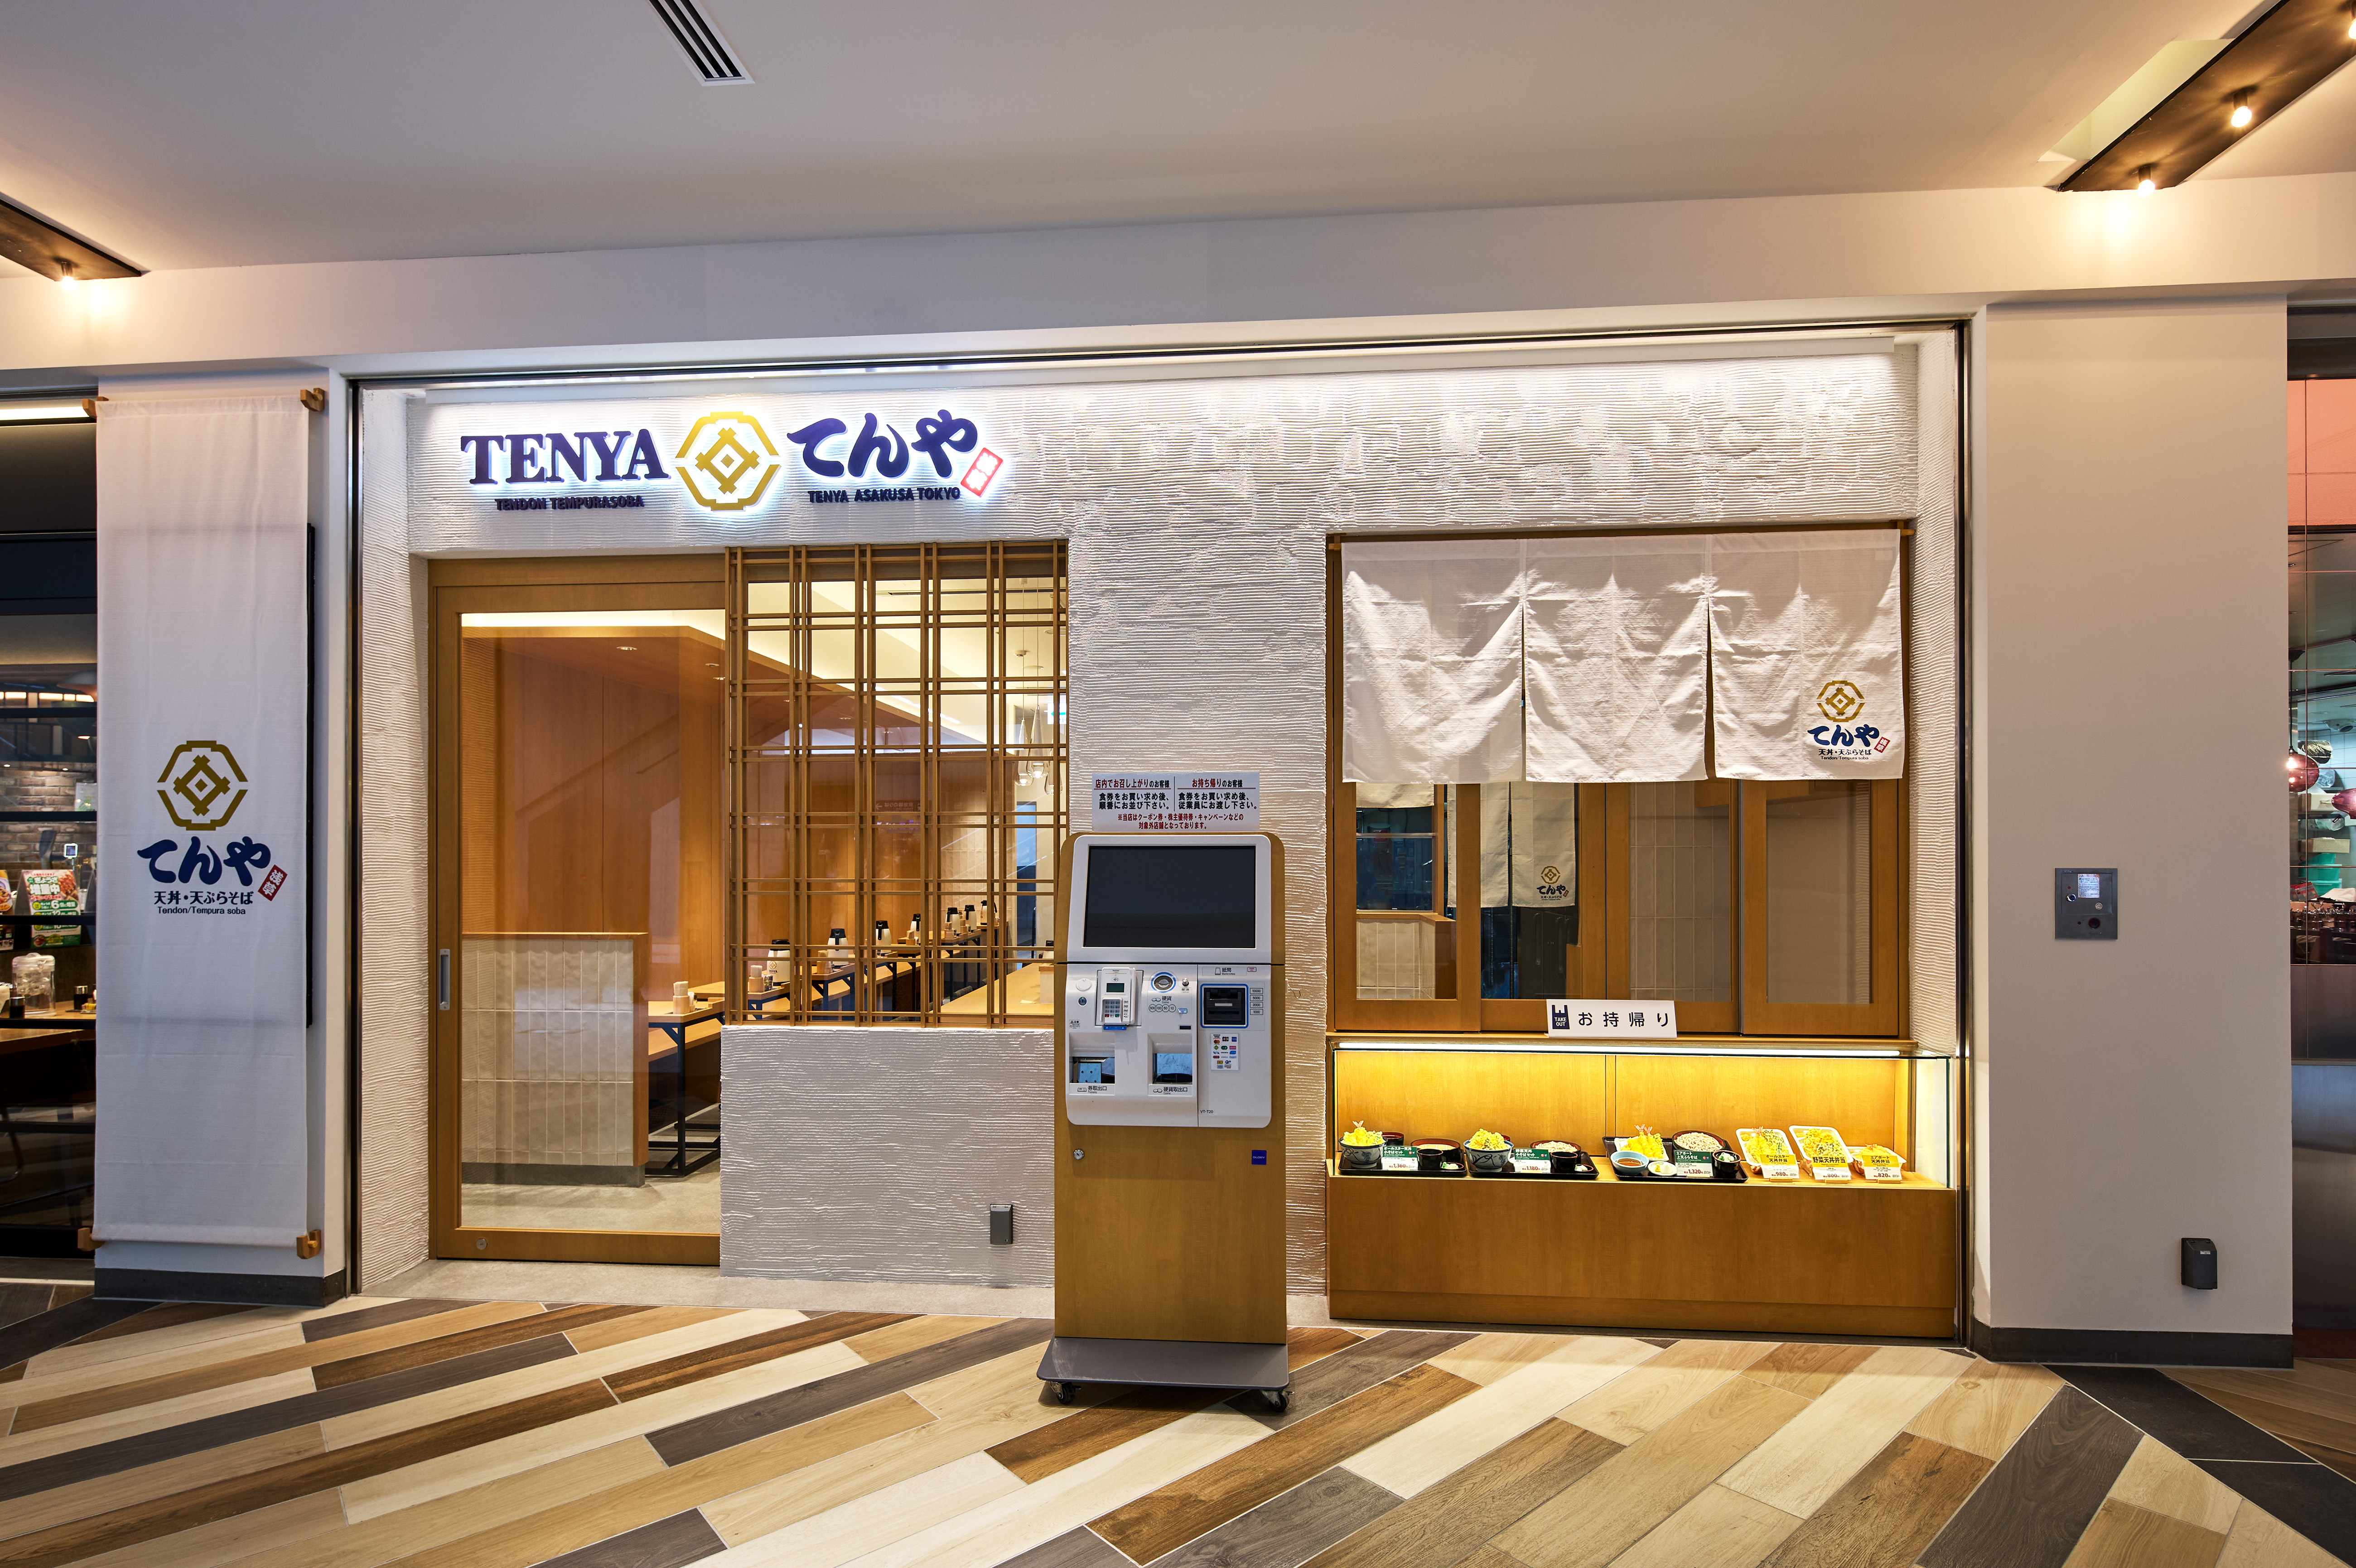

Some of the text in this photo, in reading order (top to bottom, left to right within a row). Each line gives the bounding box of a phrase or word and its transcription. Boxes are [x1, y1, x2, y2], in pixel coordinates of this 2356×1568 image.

[787, 409, 978, 479] てんや
[460, 429, 671, 485] TENYA
[808, 487, 961, 503] TENYA ASAKUSA TOKYO
[495, 495, 645, 511] TENDON TEMPURASOBA
[1807, 724, 1879, 747] てんや
[1096, 779, 1170, 788] 店内でお召し上がりのお客様
[1192, 778, 1243, 787] お持ち帰りのお客様
[1099, 792, 1169, 801] 食券をお買い求め後、
[1178, 792, 1249, 801] 食券をお買い求め後、
[1099, 801, 1169, 810] 順番にお並び下さい。
[1178, 801, 1257, 810] 従業員にお渡し下さい。
[137, 836, 271, 887] てんや
[1536, 884, 1566, 895] てんや
[154, 891, 254, 905] 天丼・天ぷらそば
[158, 907, 225, 915] Tendon/Tempura
[1578, 1012, 1669, 1028] お持帰り
